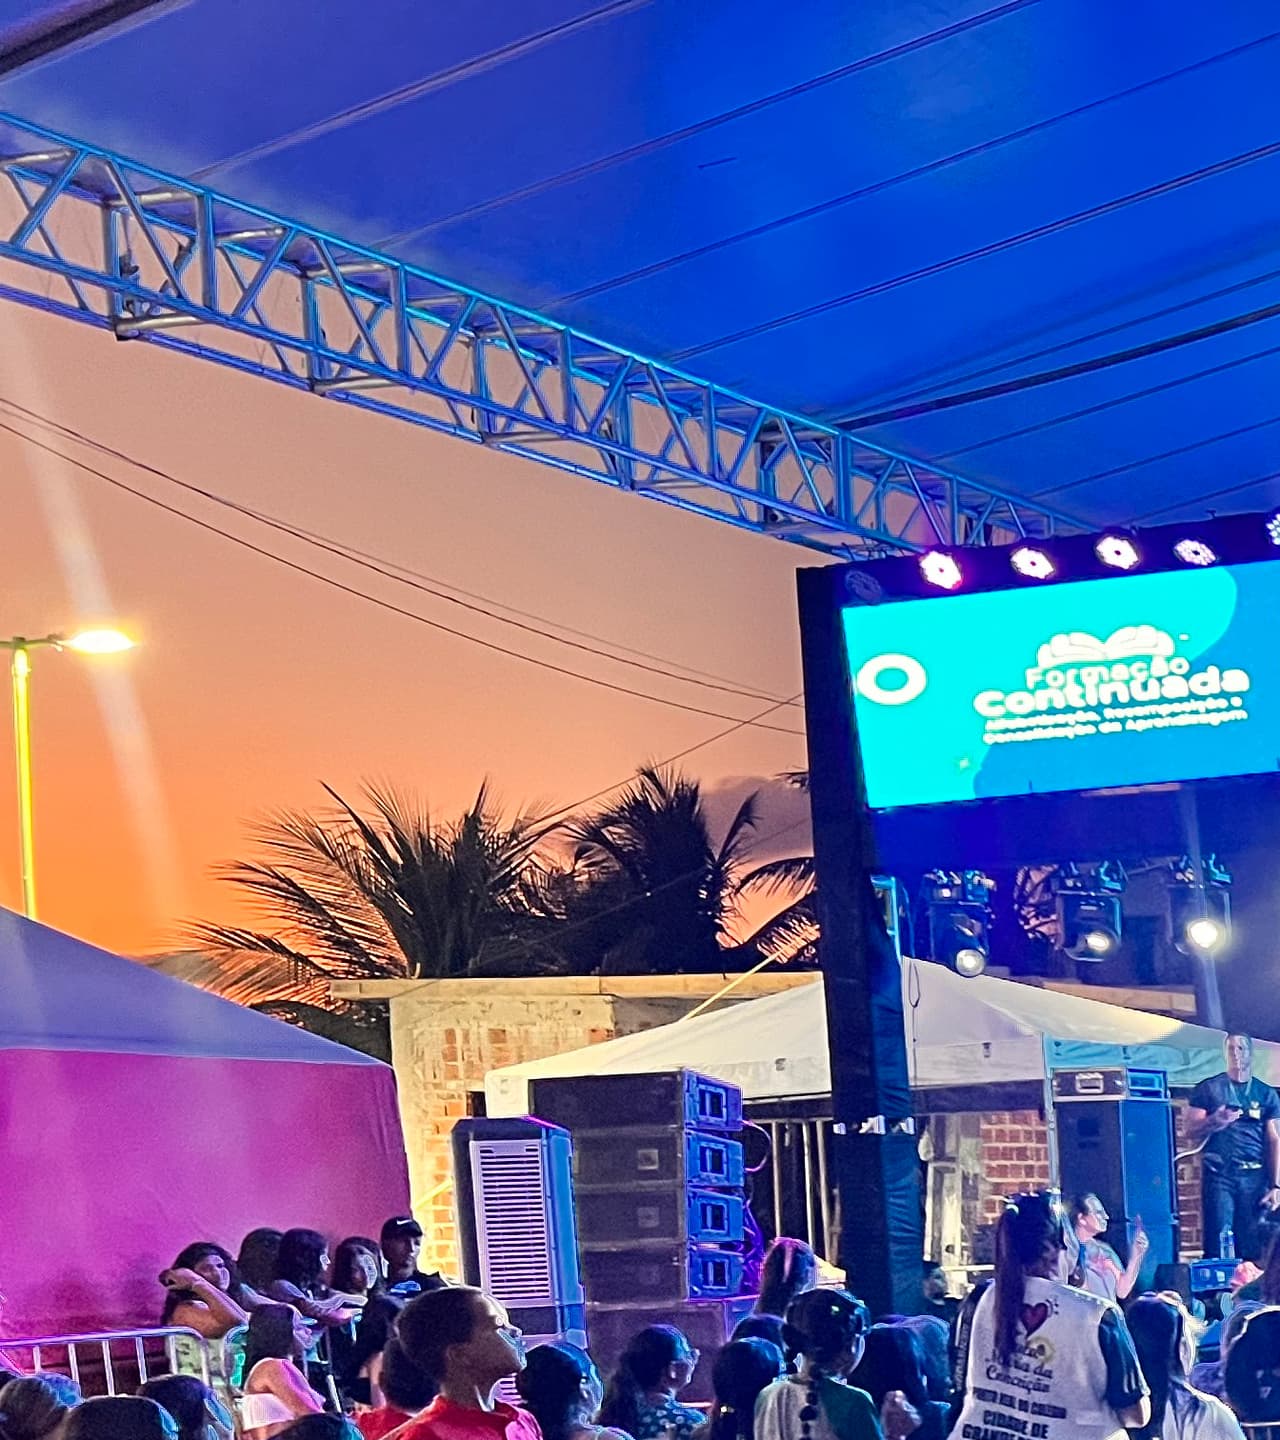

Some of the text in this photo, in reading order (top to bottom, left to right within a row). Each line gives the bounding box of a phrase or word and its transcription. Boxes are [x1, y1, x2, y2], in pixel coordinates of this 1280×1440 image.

[1024, 655, 1190, 689] Formação
[972, 664, 1250, 718] Continuada
[983, 1410, 1049, 1440] CIDADE DE
